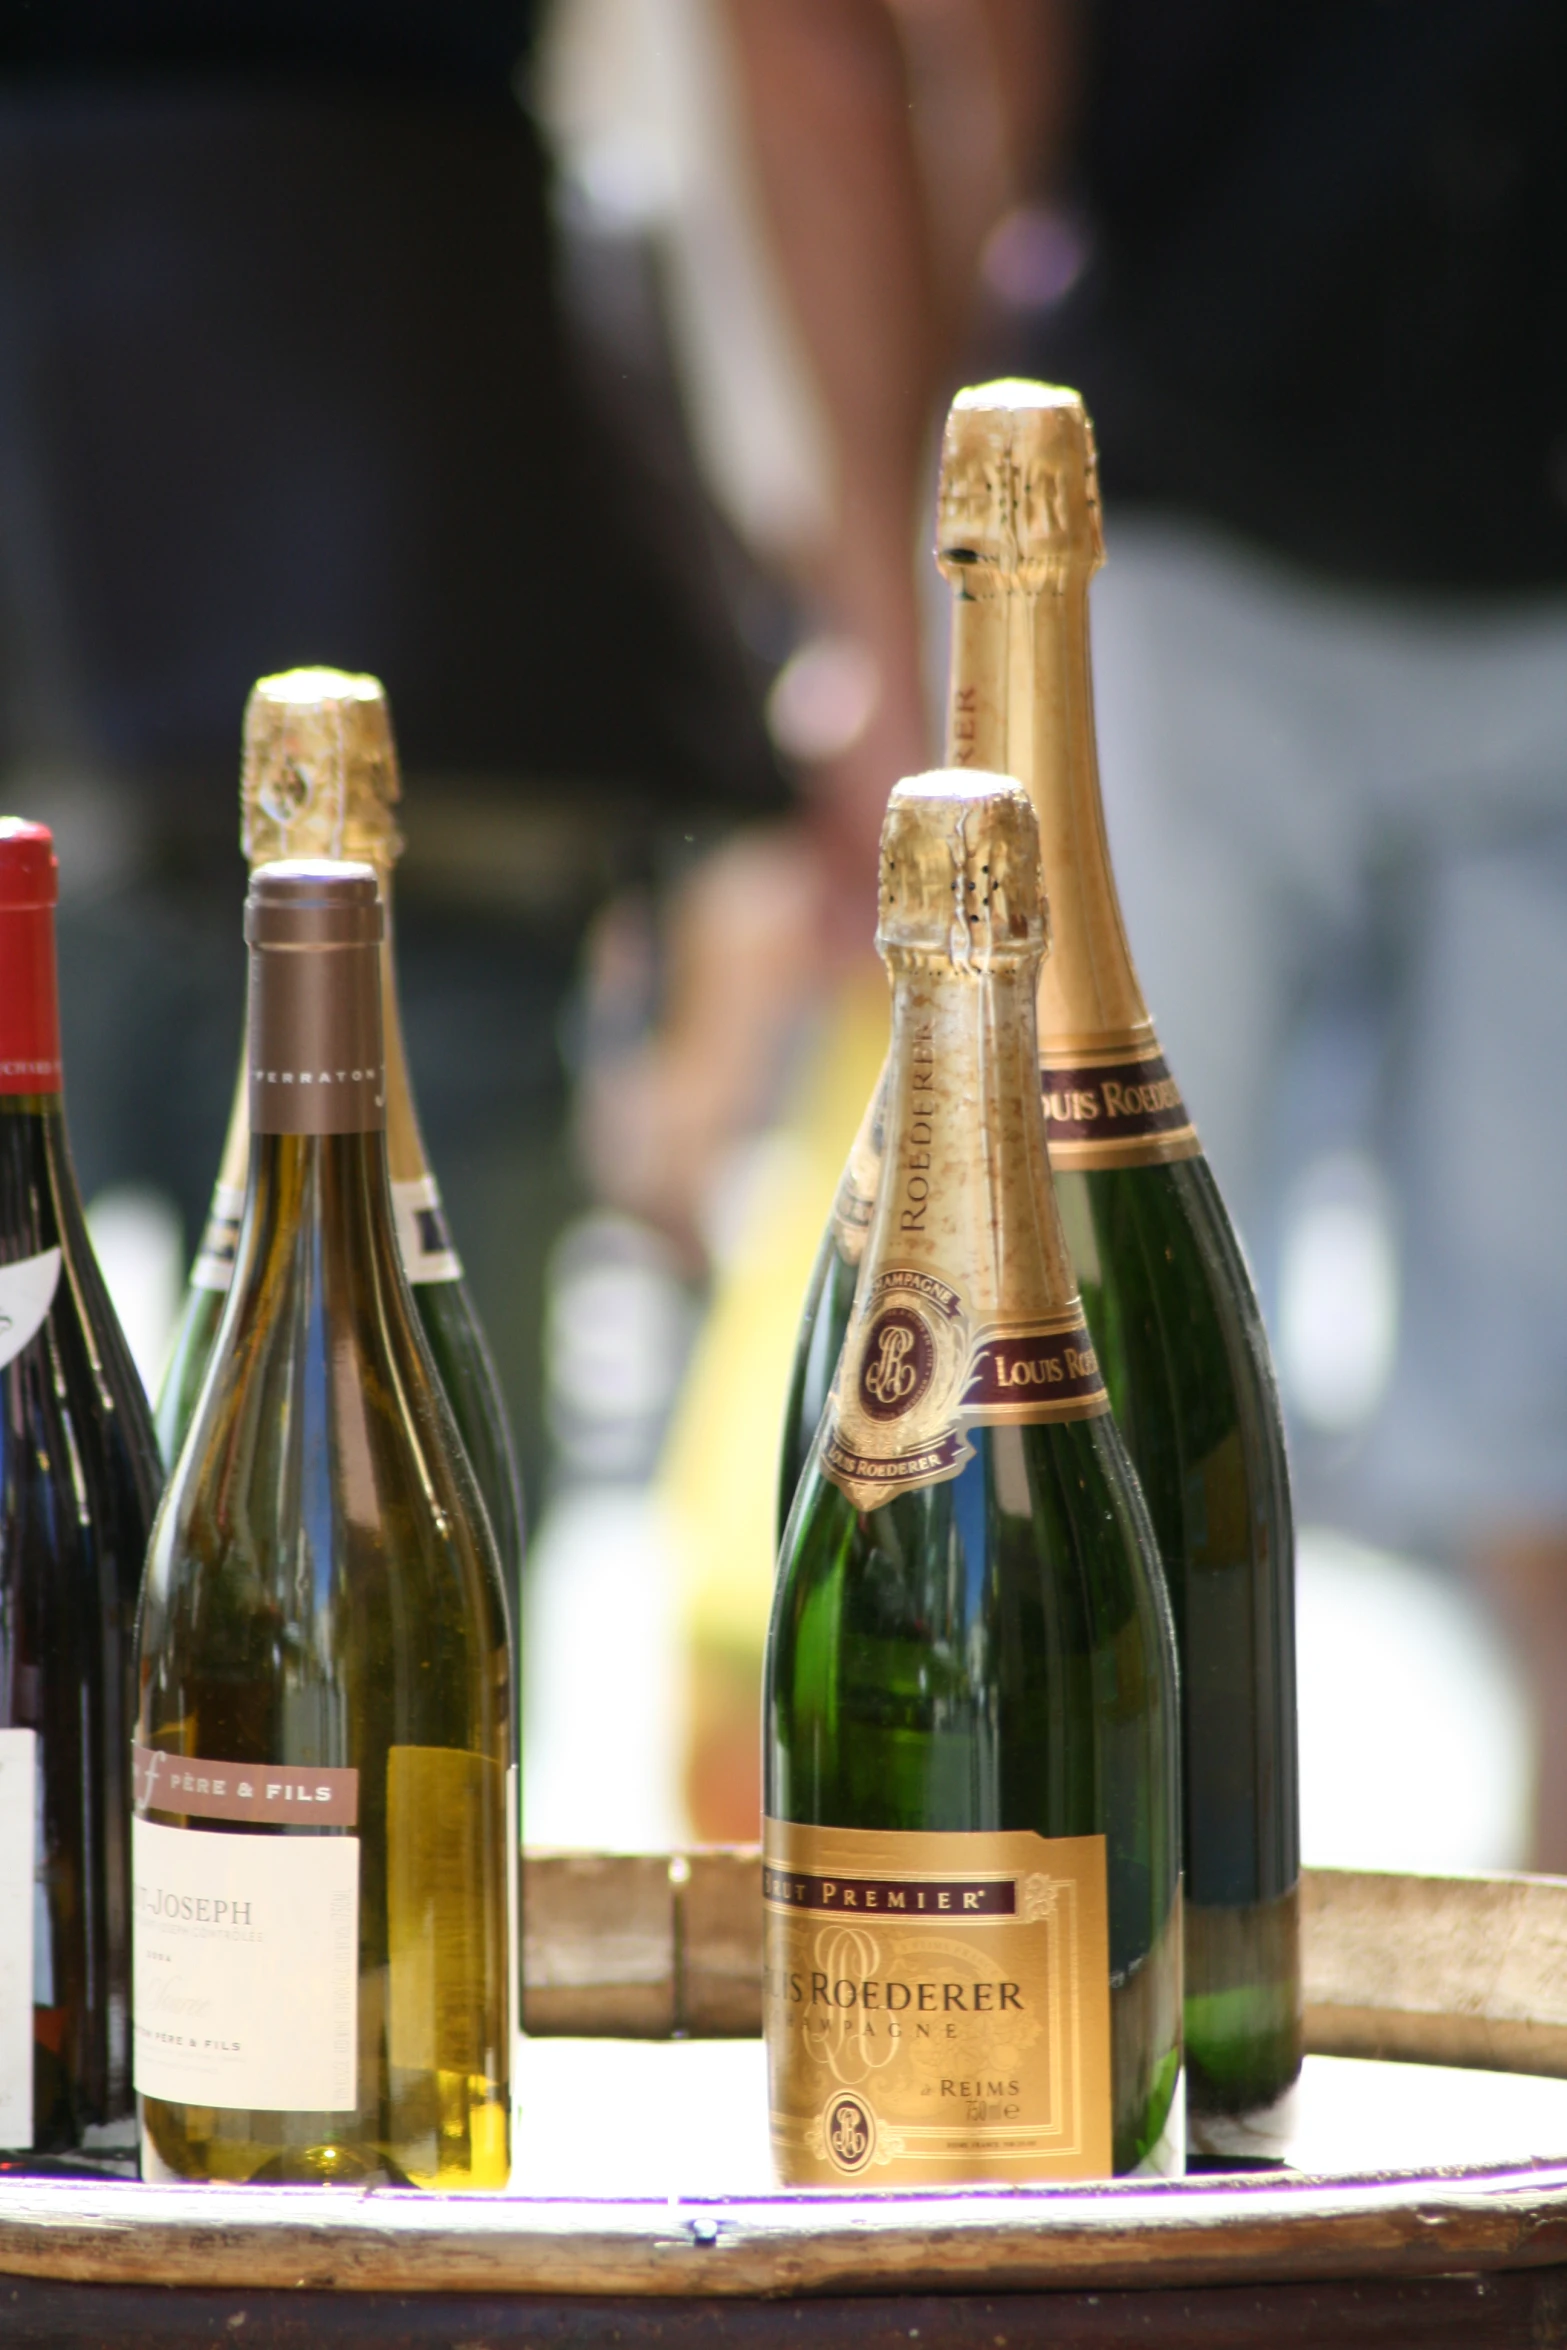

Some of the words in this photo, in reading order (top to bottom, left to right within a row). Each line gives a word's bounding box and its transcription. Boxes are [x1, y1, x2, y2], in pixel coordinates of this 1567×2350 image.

[900, 1022, 934, 1231] ROEDERER
[873, 1270, 954, 1304] HAMPAGNE
[994, 1355, 1064, 1387] LOUIS
[856, 1453, 942, 1477] ROEDERER
[170, 1773, 226, 1796] PÈRE
[237, 1783, 253, 1798] &
[266, 1784, 332, 1802] FILS
[811, 1972, 1024, 2012] ROEDERER
[205, 2039, 241, 2052] FILS
[941, 2079, 1020, 2097] REIMS
